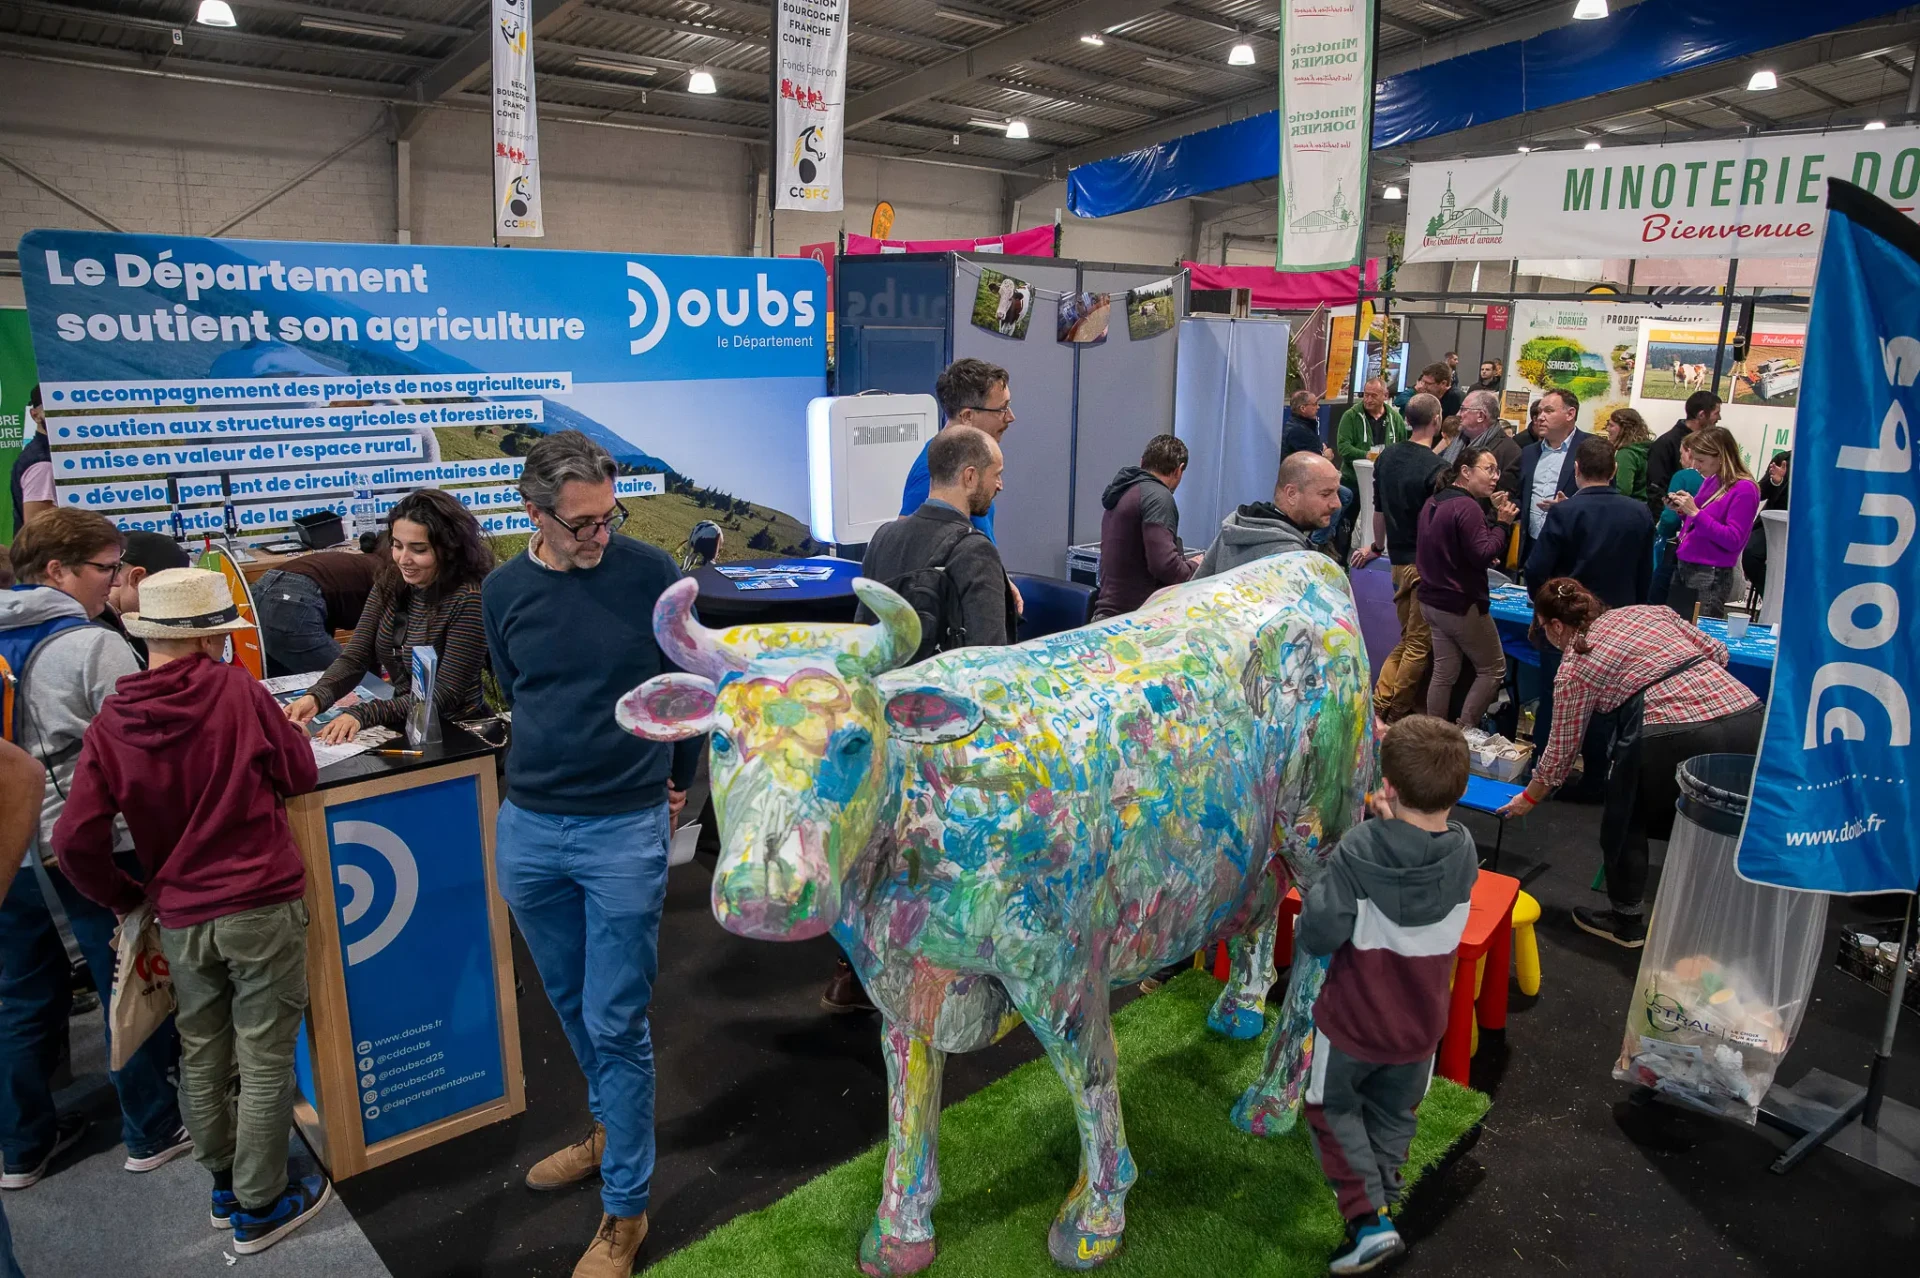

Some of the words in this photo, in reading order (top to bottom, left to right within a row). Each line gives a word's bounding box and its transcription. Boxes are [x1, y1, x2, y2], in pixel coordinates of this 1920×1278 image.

[783, 2, 840, 22] BOURGOGNE
[782, 33, 812, 48] COMTE
[789, 19, 832, 37] FRANCHE
[782, 58, 805, 73] Fonds
[806, 62, 837, 77] Éperon
[789, 186, 830, 200] CCBFC
[1562, 154, 1826, 211] MINOTERIE
[504, 219, 537, 230] CCBFC
[1641, 213, 1814, 243] Bienvenue
[1437, 235, 1470, 247] tradition
[44, 249, 106, 287] Le
[114, 248, 429, 300] Département
[57, 303, 270, 343] soutient
[279, 316, 358, 342] son
[366, 307, 586, 352] agriculture
[1558, 316, 1588, 326] DORNIER
[716, 334, 729, 348] le
[732, 334, 814, 351] Département
[1761, 335, 1795, 345] Production
[1547, 361, 1579, 371] SEMENCES
[70, 382, 281, 405] accompagnement
[283, 381, 320, 398] des
[323, 379, 392, 401] projets
[394, 379, 418, 395] de
[420, 380, 453, 393] nos
[455, 376, 566, 396] agriculteurs,
[76, 418, 166, 438] soutien
[169, 421, 213, 434] aux
[216, 414, 325, 432] structures
[328, 410, 416, 432] agricoles
[419, 409, 438, 424] et
[440, 405, 539, 423] forestières,
[81, 450, 139, 470] mise
[143, 452, 171, 466] en
[179, 443, 246, 465] valeur
[248, 444, 275, 460] de
[364, 437, 417, 454] rural,
[85, 479, 263, 504] dévelopement
[266, 476, 292, 495] de
[371, 462, 487, 485] alimentaires
[489, 461, 516, 477] de
[240, 509, 266, 525] de
[269, 507, 288, 522] la
[474, 491, 491, 505] la
[482, 518, 504, 532] de
[374, 1019, 444, 1048] www.doubs.fr
[376, 1038, 432, 1065] @cddoubs
[378, 1051, 445, 1082] @doubscd25
[380, 1066, 446, 1098] @doubscd25
[382, 1069, 487, 1114] @departementdoubs
